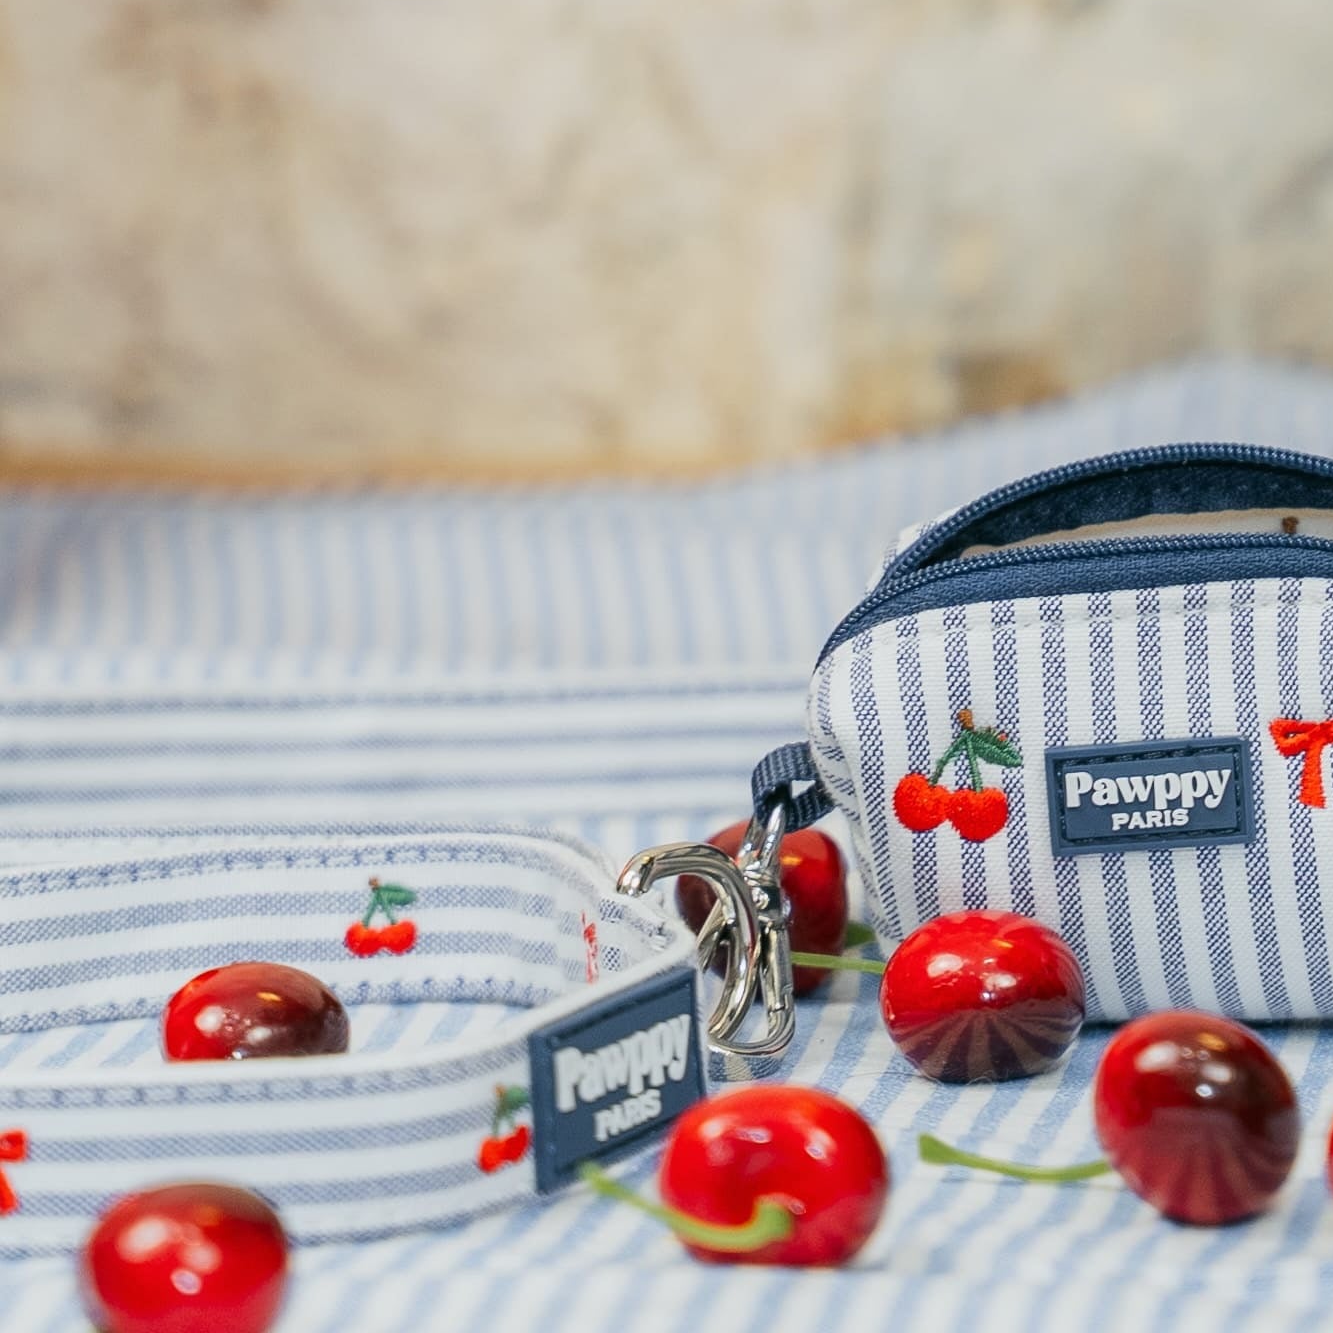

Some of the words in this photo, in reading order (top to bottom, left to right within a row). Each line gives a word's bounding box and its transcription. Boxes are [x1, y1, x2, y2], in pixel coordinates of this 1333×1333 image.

[1065, 768, 1232, 810] Pawppy
[1111, 808, 1190, 831] PARIS
[554, 1013, 691, 1113] Pawppy
[593, 1088, 662, 1142] PARIS
